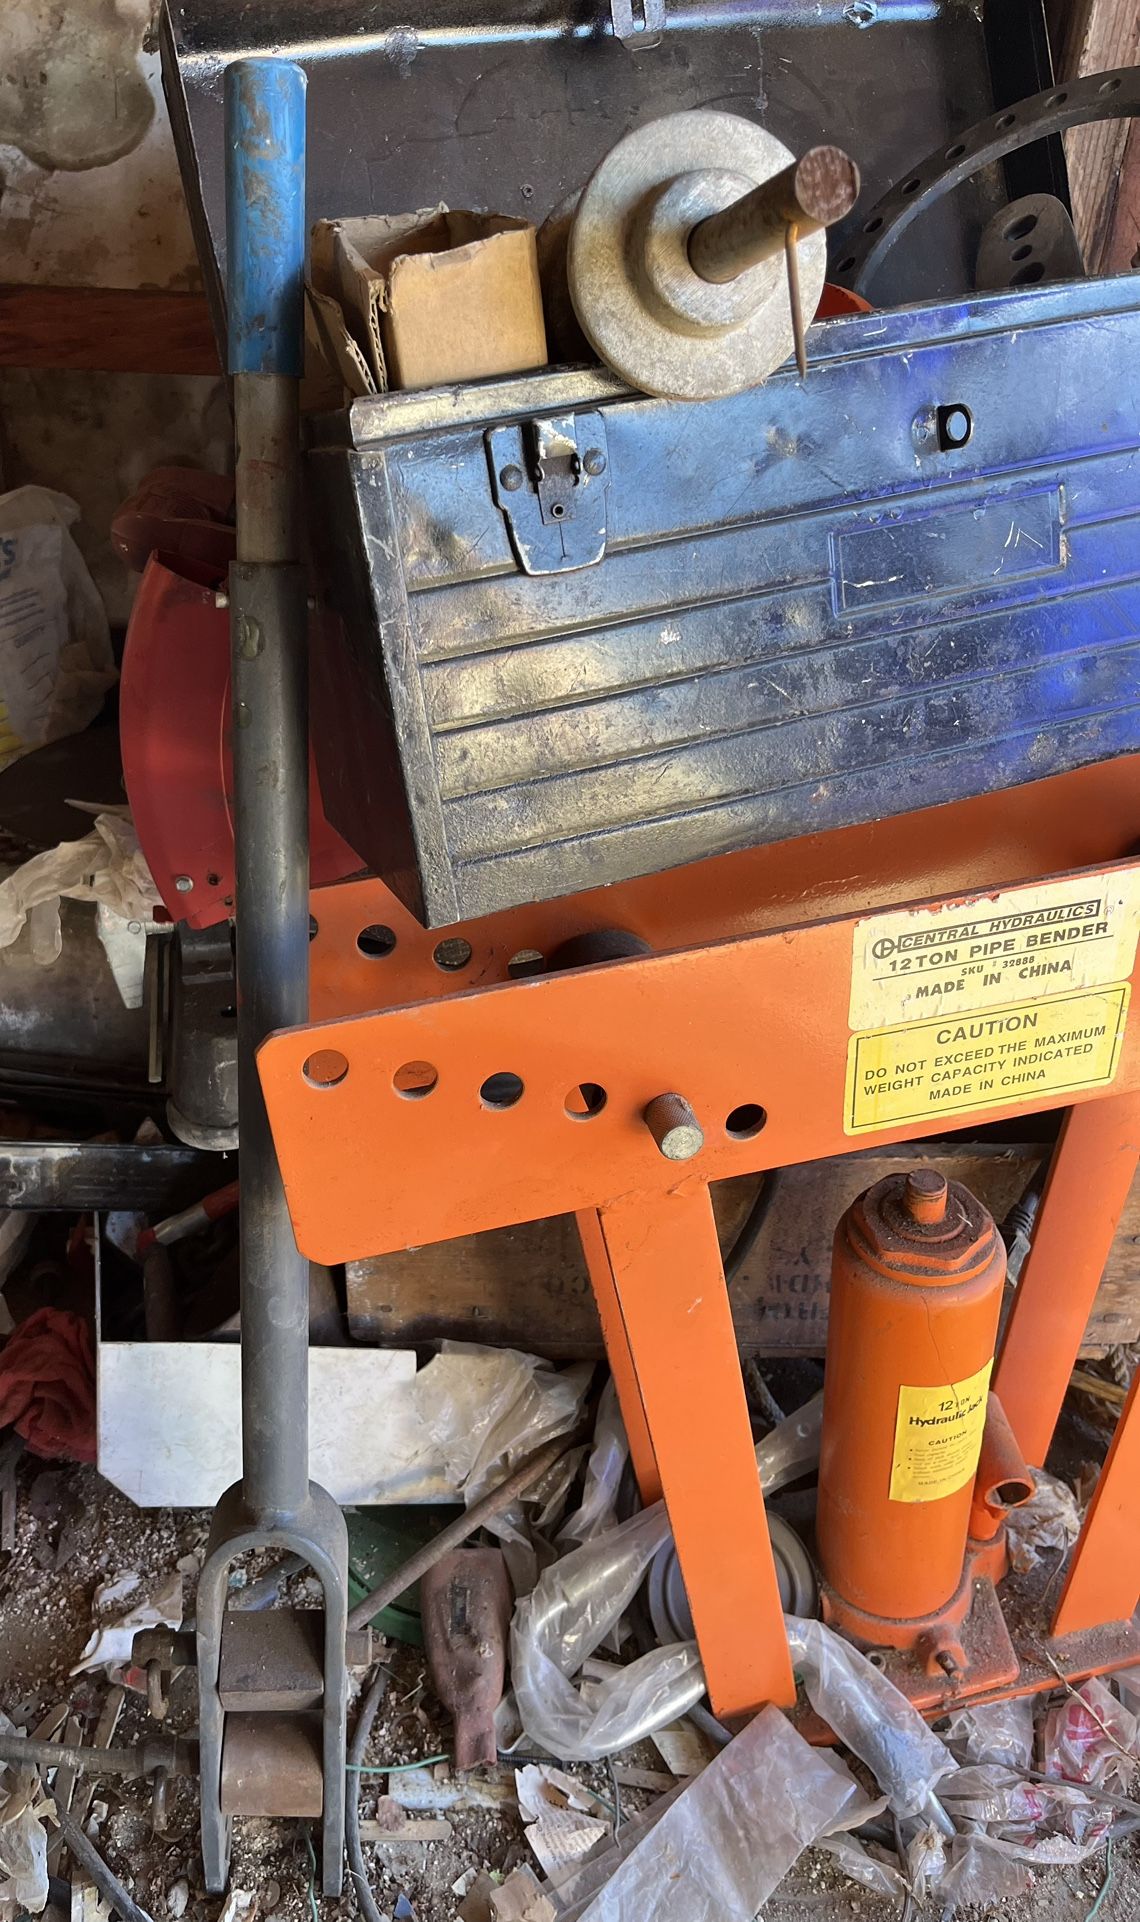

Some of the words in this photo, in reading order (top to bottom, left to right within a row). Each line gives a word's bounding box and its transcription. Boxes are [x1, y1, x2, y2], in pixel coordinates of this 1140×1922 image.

[902, 926, 979, 948] CENTRAL
[989, 904, 1094, 932] HYDRAULICS
[969, 938, 1016, 958] PIPE
[1026, 922, 1108, 947] BENDER
[916, 979, 965, 998] MADE
[983, 972, 1002, 986] IN
[1018, 960, 1072, 979] CHINA
[961, 965, 984, 976] SKU
[1002, 956, 1035, 968] 32888
[936, 1013, 1038, 1044] CAUTION
[865, 1068, 887, 1080] DO
[895, 1060, 927, 1074] NOT
[934, 1047, 994, 1067] EXCEED
[998, 1040, 1027, 1054] THE
[1034, 1025, 1106, 1048] MAXIMUM
[864, 1076, 924, 1095] WEIGHT
[931, 1060, 1006, 1083] CAPACITY
[1013, 1043, 1093, 1067] INDICATED
[929, 1084, 972, 1100] MADE
[979, 1079, 994, 1090] IN
[1001, 1069, 1046, 1086] CHINA
[909, 1409, 966, 1427] Hydraulic
[938, 1400, 953, 1411] 12
[928, 1430, 967, 1446] CAUTION
